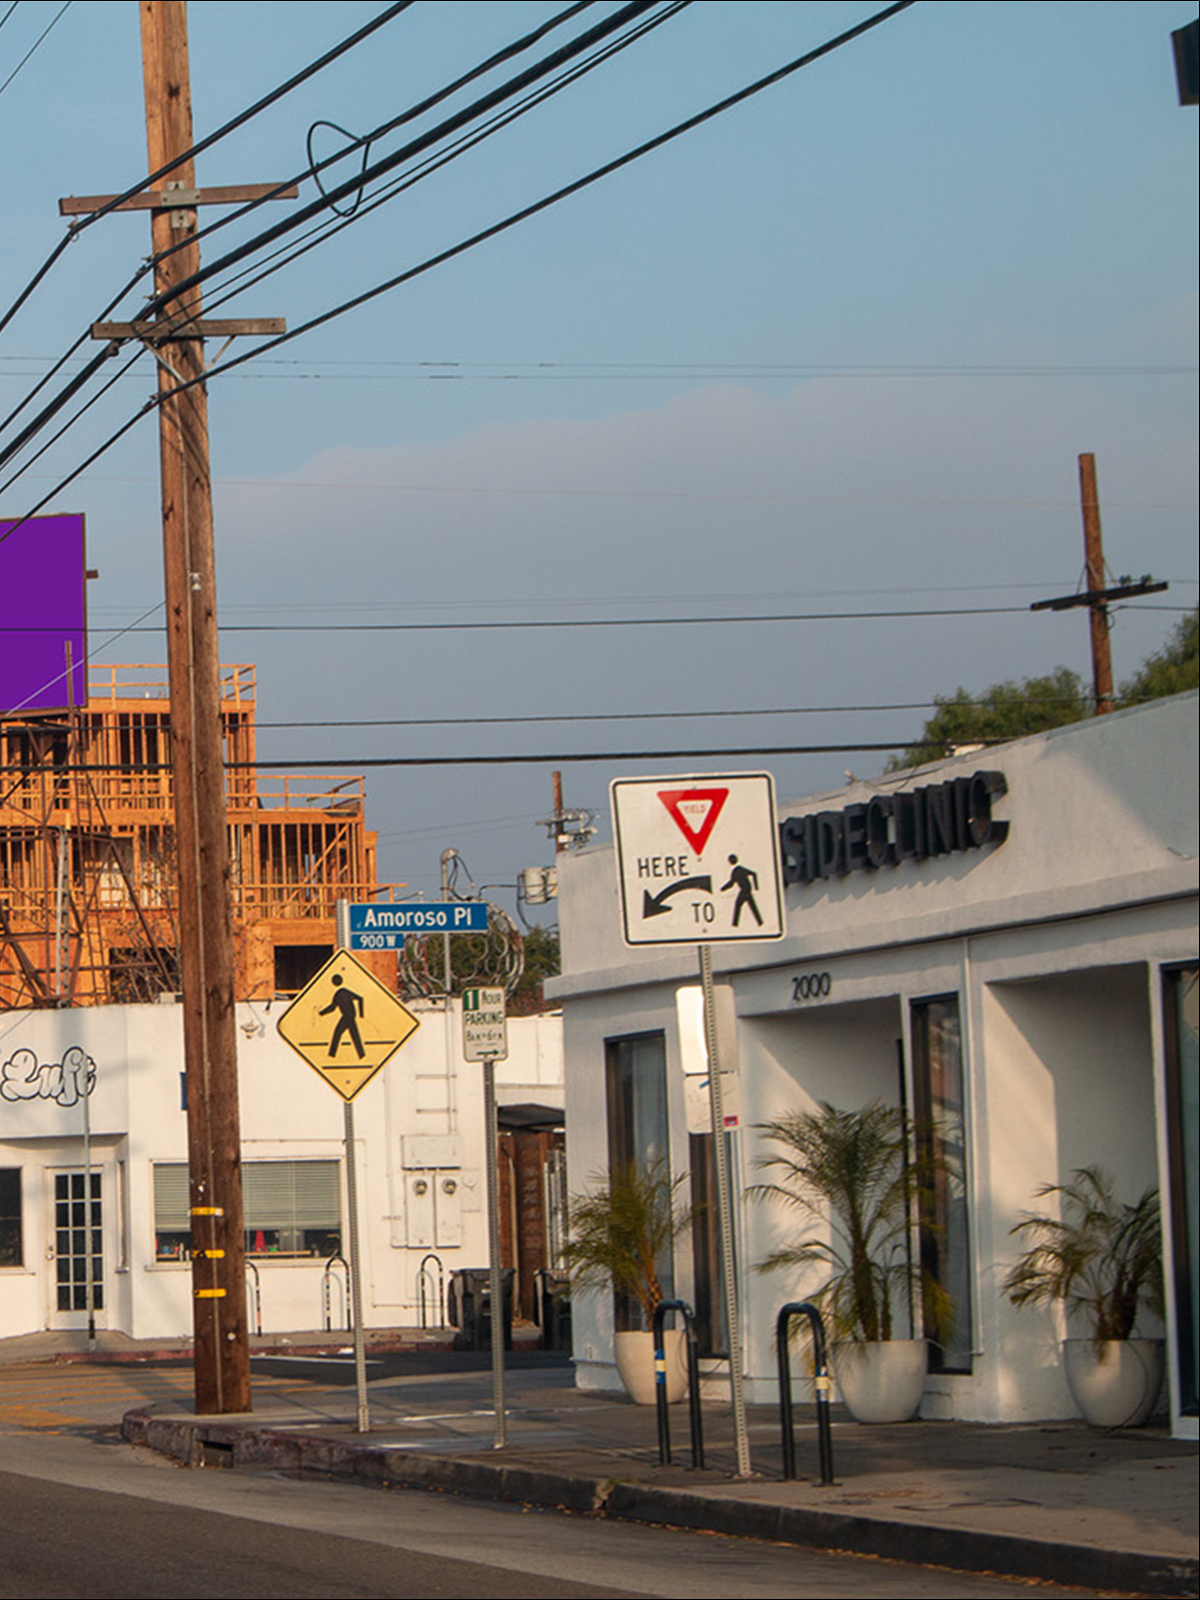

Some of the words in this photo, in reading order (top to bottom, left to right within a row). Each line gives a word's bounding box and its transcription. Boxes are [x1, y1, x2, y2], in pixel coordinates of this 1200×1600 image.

[684, 803, 707, 814] YIELD
[780, 770, 1010, 886] SIDECLINIC
[637, 856, 690, 878] HERE
[364, 908, 447, 928] Amoroso
[454, 907, 472, 926] Pl
[691, 902, 715, 923] TO
[360, 935, 384, 948] 900
[386, 935, 396, 947] W
[791, 972, 831, 1001] 2000
[467, 991, 473, 1009] 1
[481, 990, 501, 1005] HOUR
[465, 1010, 503, 1026] PARKING
